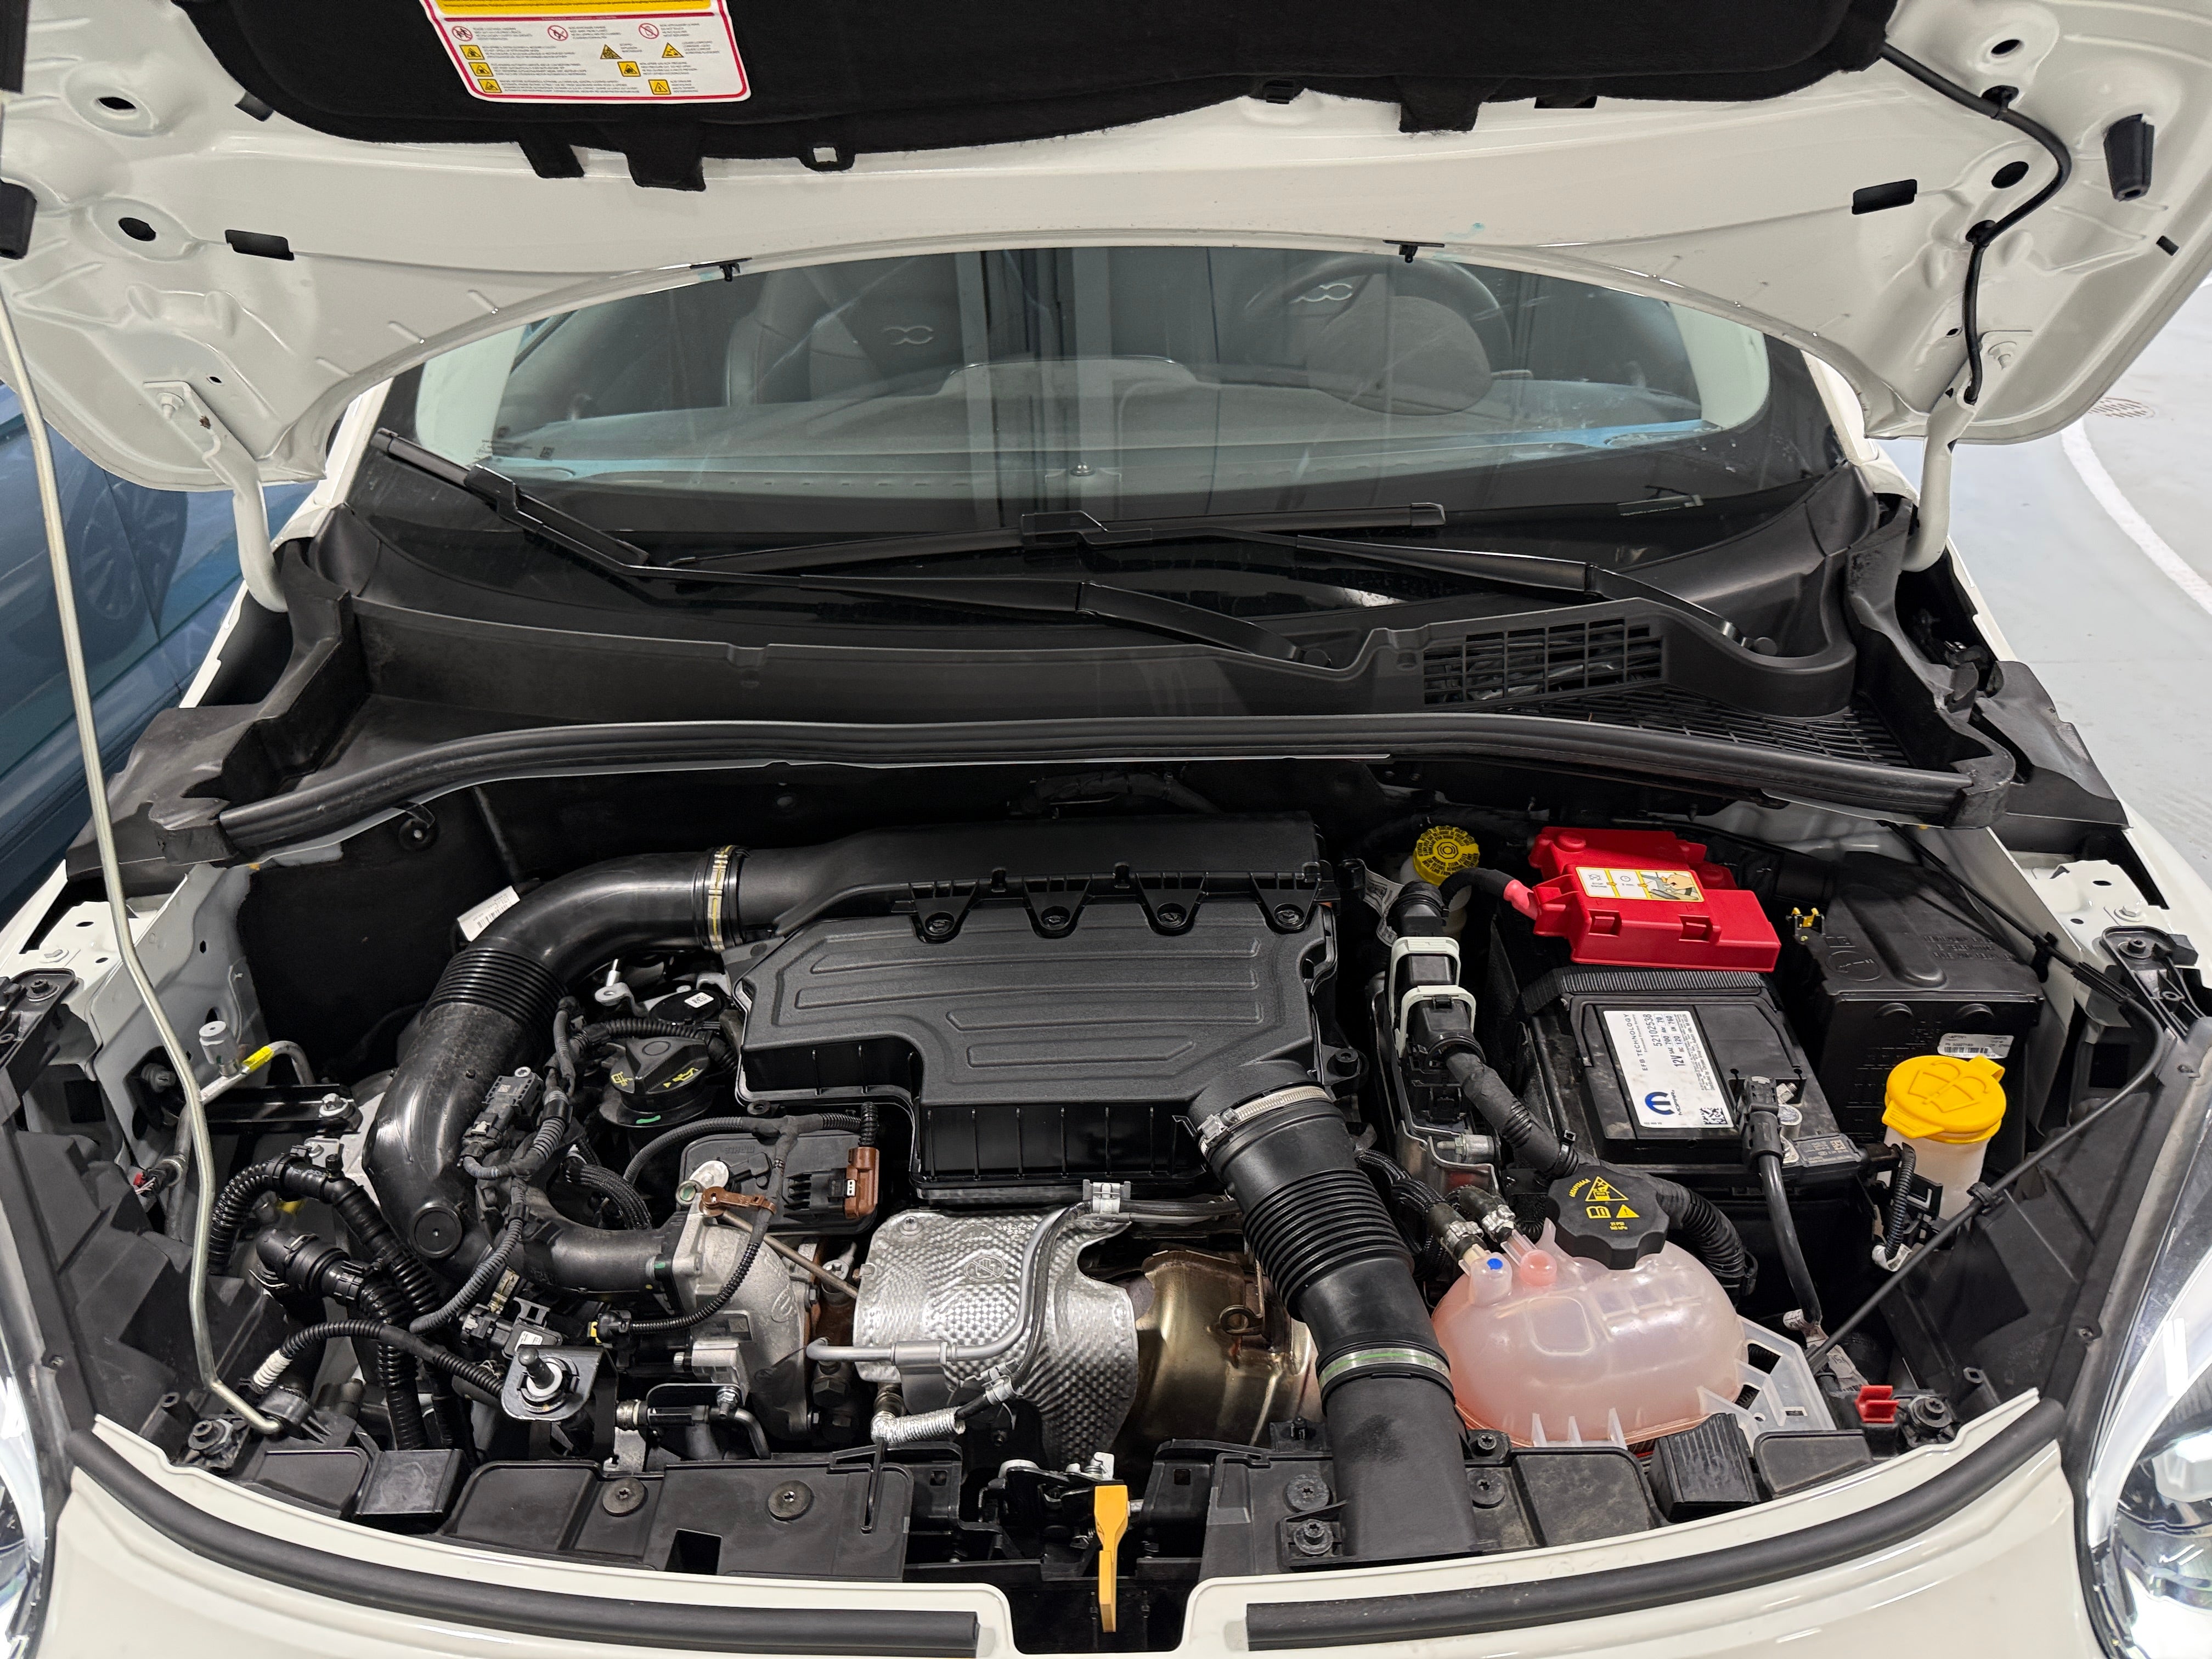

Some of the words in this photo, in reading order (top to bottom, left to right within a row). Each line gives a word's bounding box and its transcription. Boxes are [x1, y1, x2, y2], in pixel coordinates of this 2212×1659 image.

[1666, 1016, 1674, 1024] 760
[1623, 1013, 1643, 1057] TECHNOLOGY
[1643, 1014, 1662, 1047] 52102538
[1663, 1036, 1672, 1045] 700
[1673, 1036, 1683, 1045] 120
[1639, 1059, 1648, 1071] EFB
[1670, 1055, 1686, 1066] 12V
